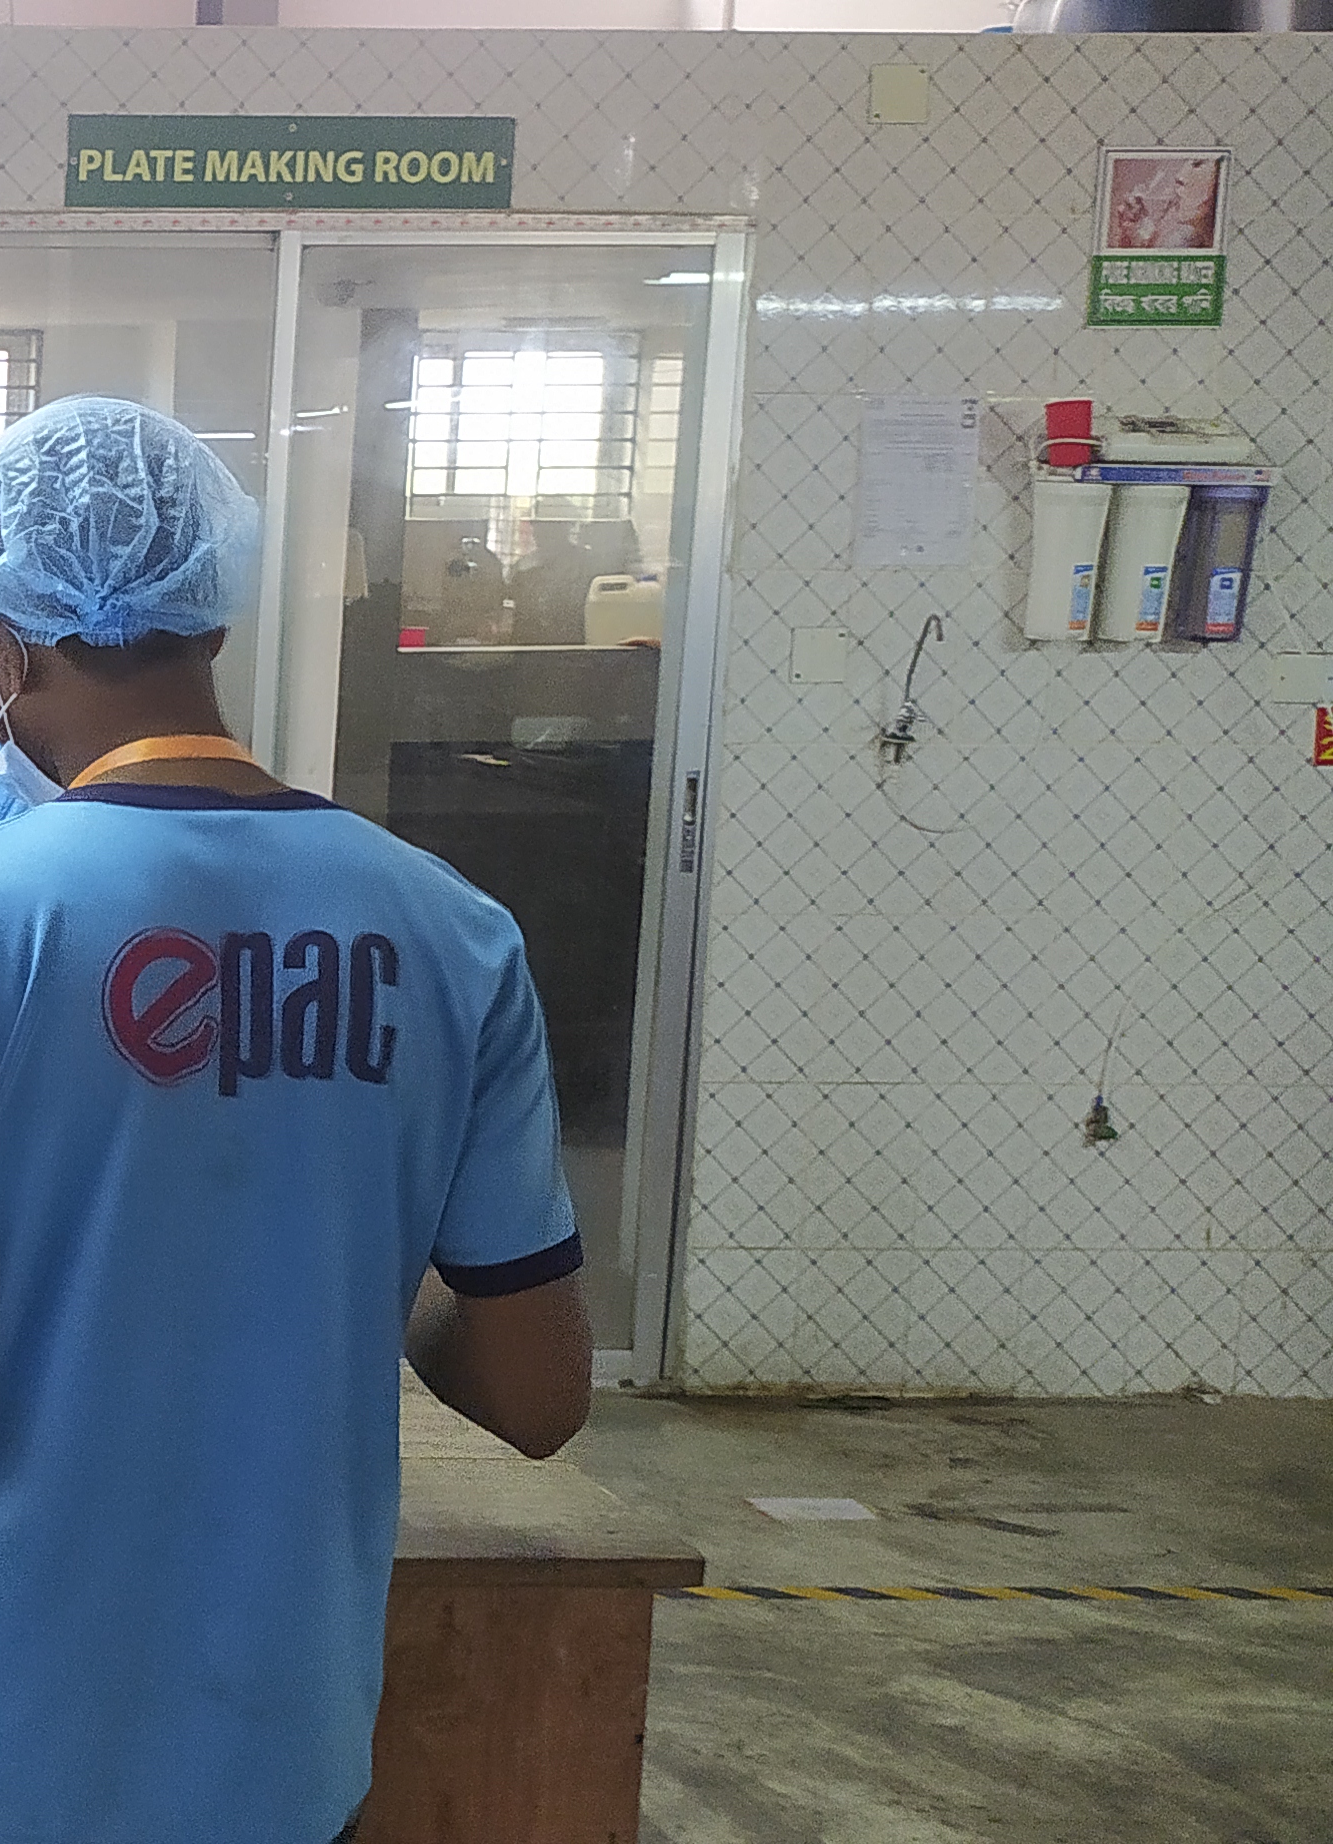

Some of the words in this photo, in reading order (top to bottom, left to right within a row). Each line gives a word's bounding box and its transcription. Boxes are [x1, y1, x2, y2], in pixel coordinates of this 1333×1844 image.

[78, 150, 194, 182] PLATE
[204, 151, 363, 183] MAKING
[374, 151, 494, 184] ROOM
[102, 926, 399, 1096] epac
